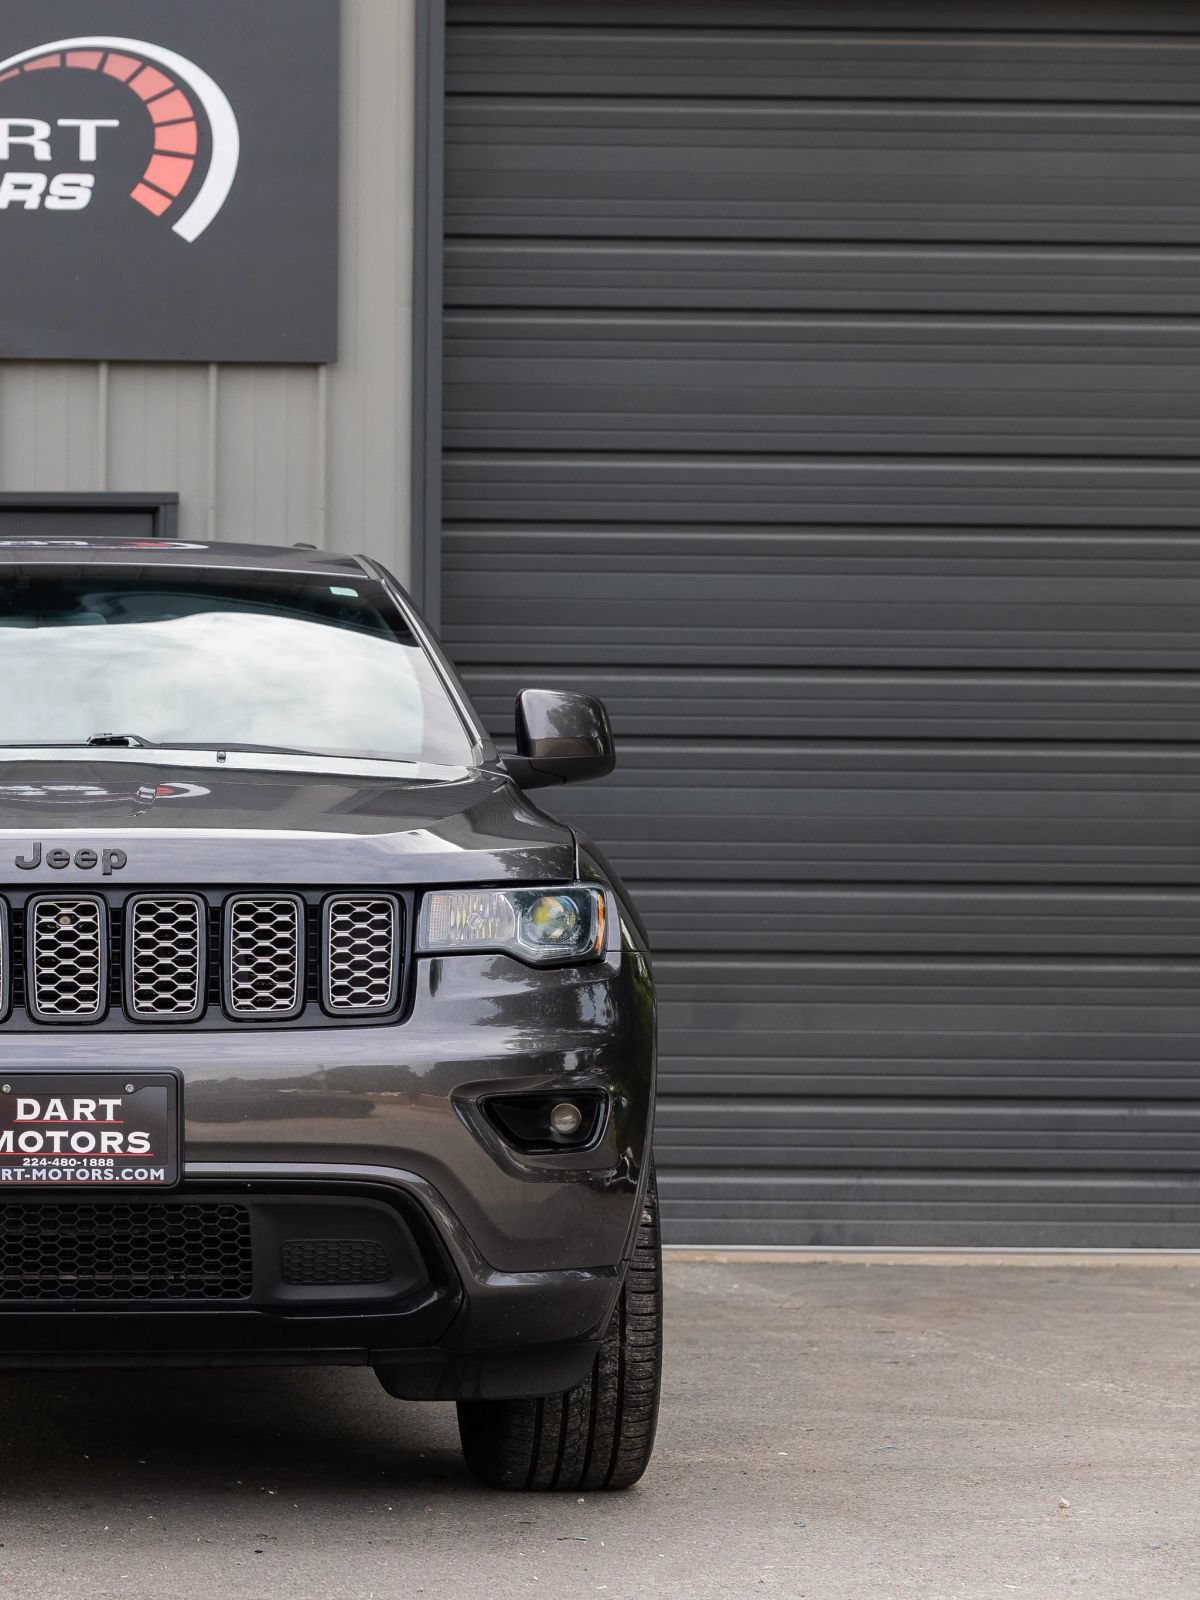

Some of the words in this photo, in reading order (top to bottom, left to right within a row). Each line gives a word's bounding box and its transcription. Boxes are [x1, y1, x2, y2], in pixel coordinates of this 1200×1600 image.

[14, 842, 128, 876] Jeep
[15, 1098, 122, 1121] DART
[22, 1157, 114, 1167] 224-480-1888
